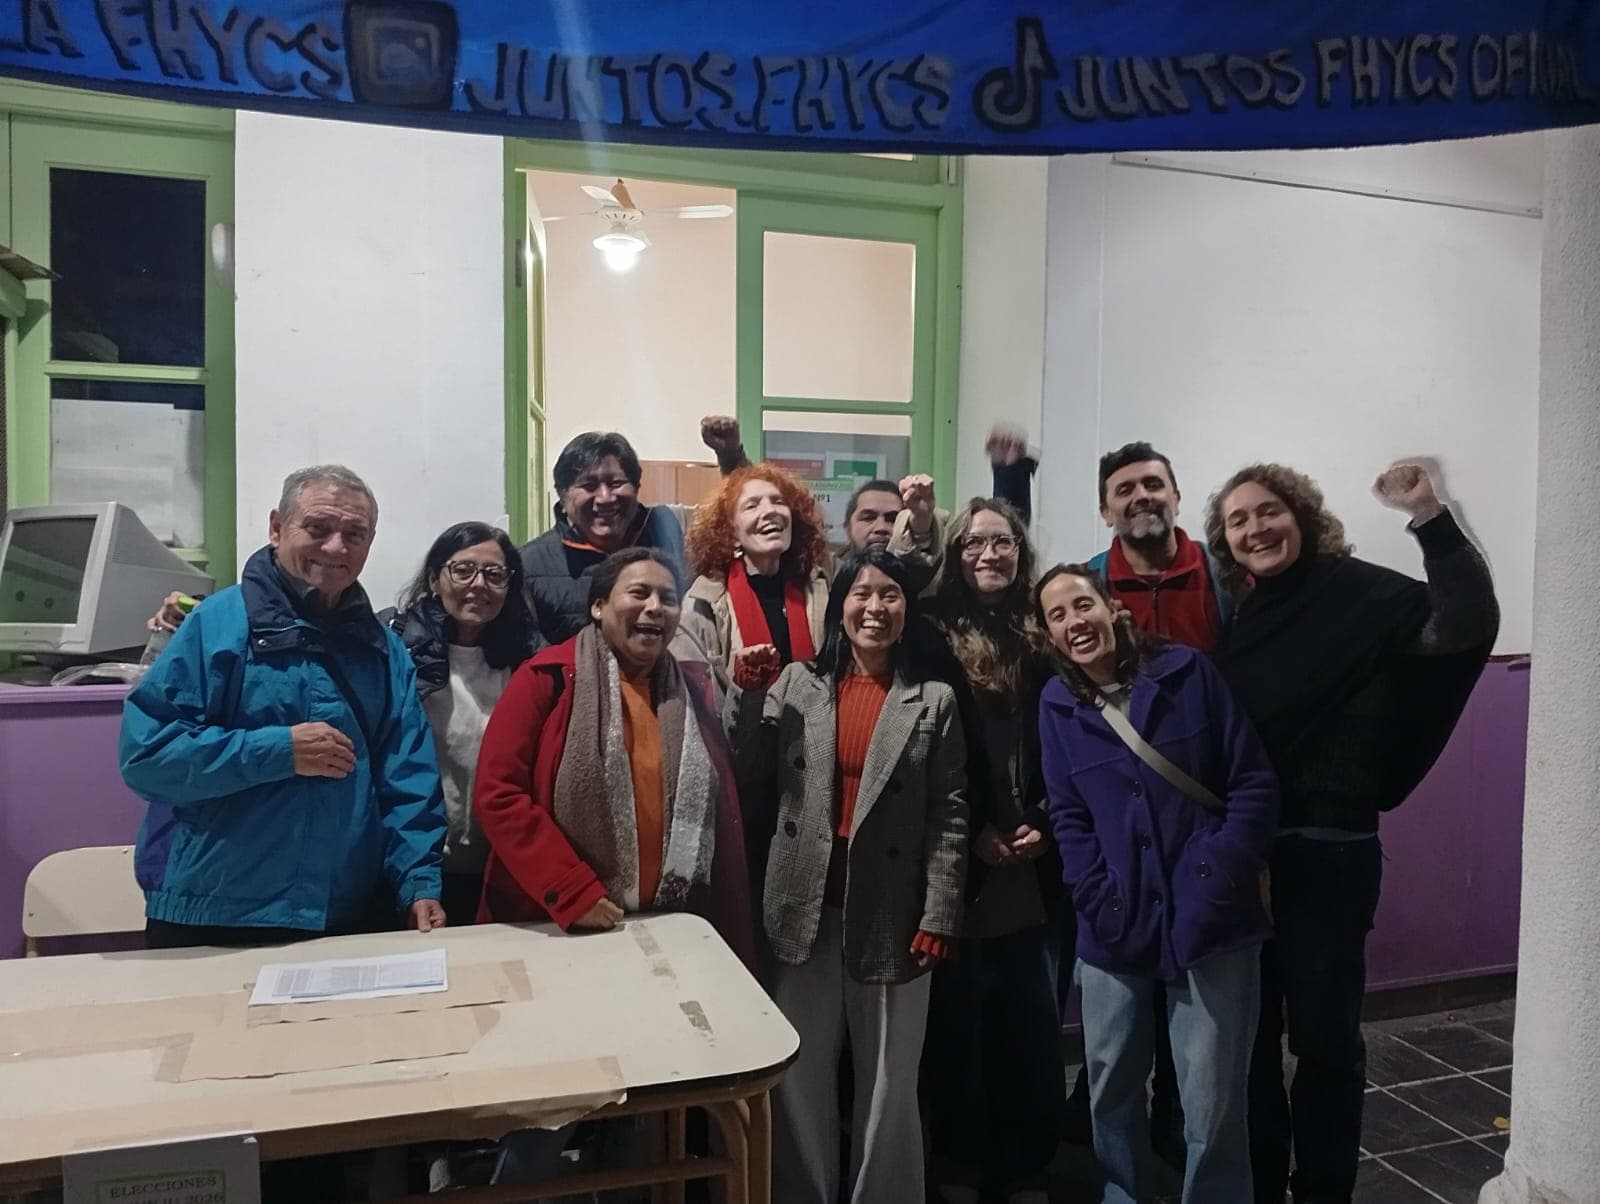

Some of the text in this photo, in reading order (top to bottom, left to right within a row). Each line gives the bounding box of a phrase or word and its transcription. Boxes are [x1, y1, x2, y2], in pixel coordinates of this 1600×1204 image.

[95, 0, 344, 99] FHYCS
[1057, 47, 1307, 121] JUNTOS
[1315, 32, 1460, 107] FHYCS
[110, 1175, 217, 1199] ELECCIONES
